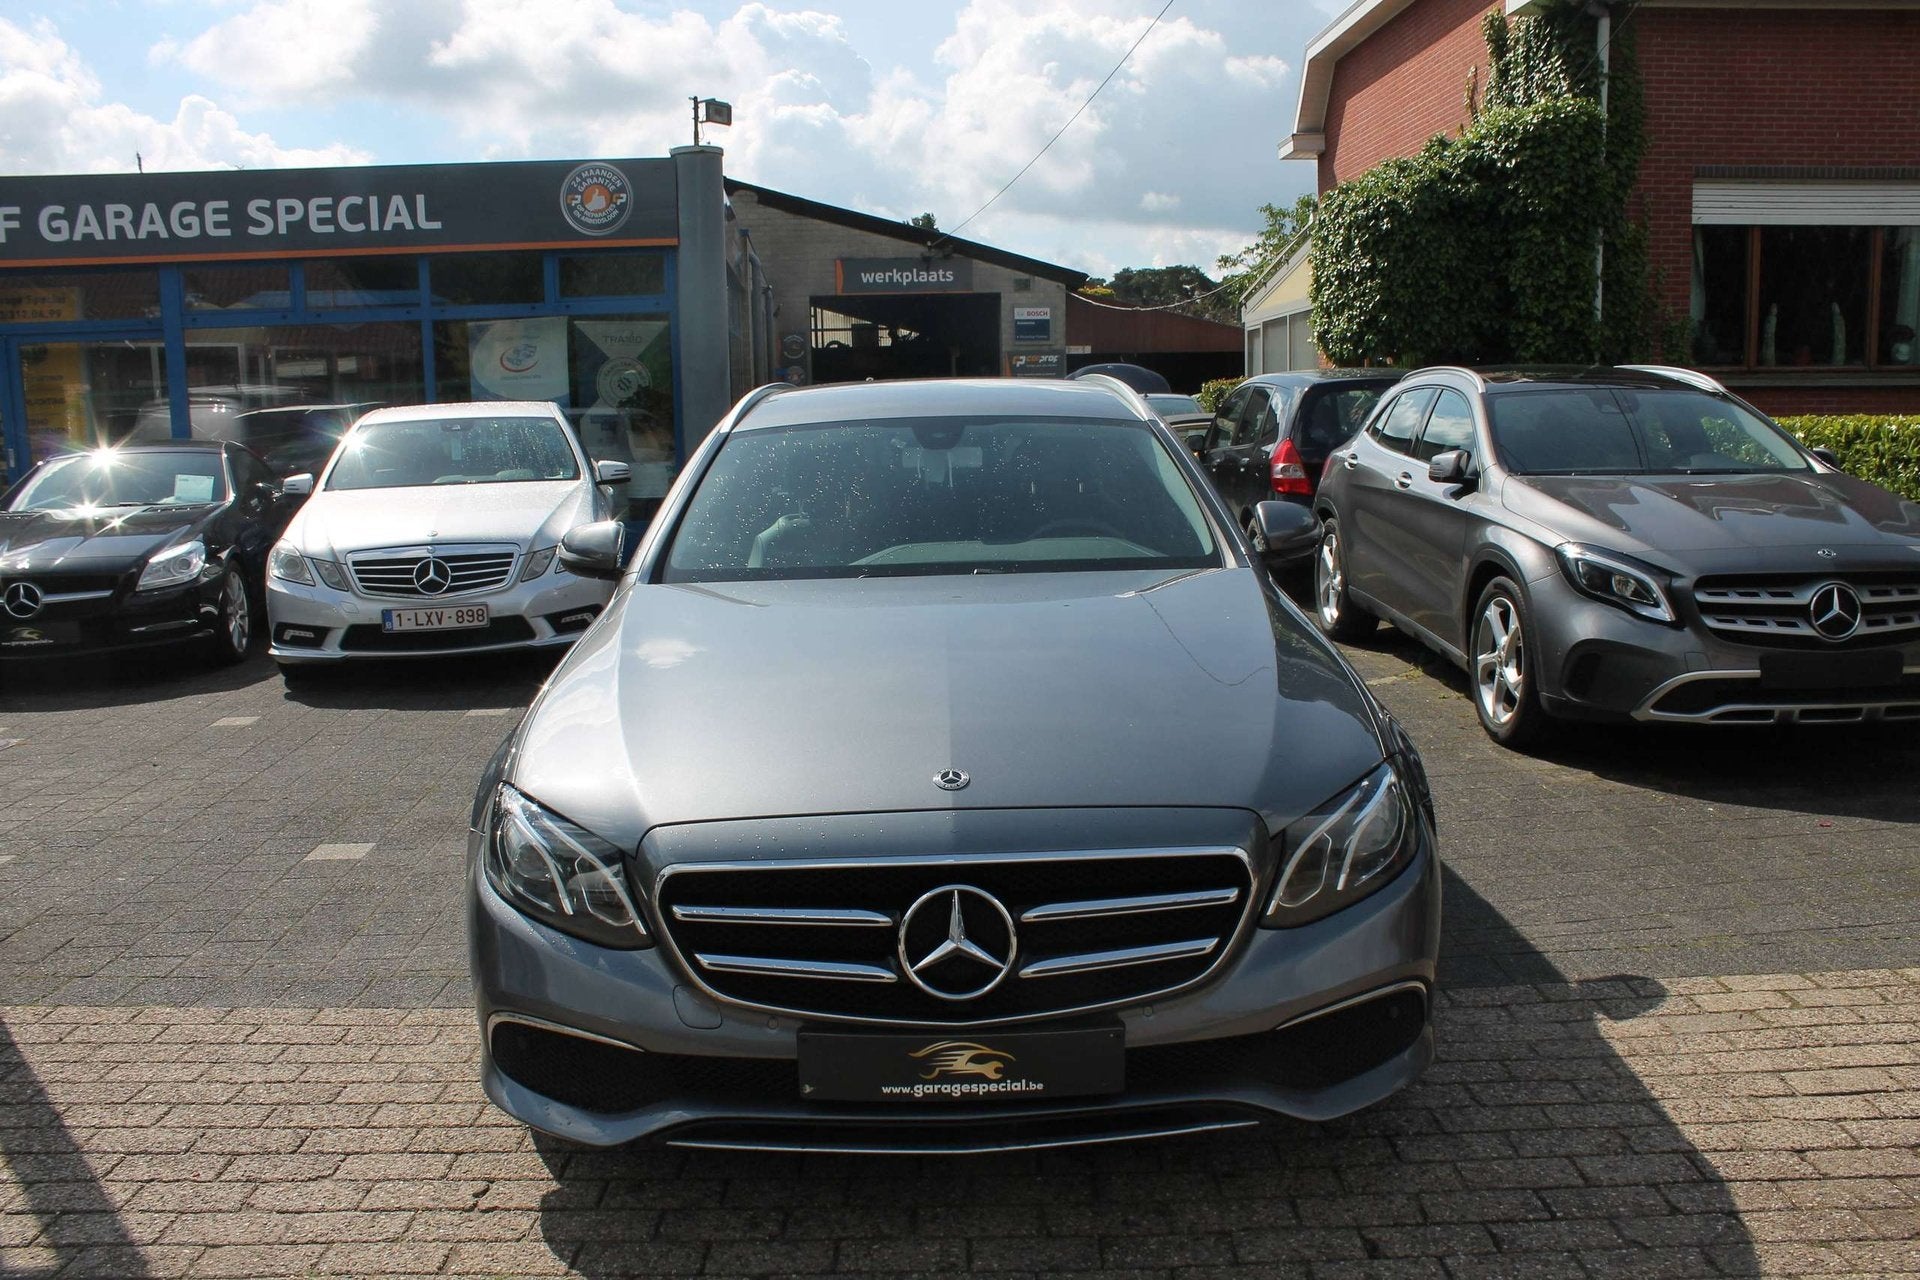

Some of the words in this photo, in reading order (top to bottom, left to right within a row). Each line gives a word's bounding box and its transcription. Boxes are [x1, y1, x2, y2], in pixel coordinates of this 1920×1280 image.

[571, 176, 581, 188] 24
[581, 168, 623, 187] MAANDEN
[578, 177, 617, 192] GARANTIE
[38, 201, 232, 242] GARAGE
[247, 194, 442, 236] SPECIAL
[861, 268, 954, 286] werkplaats
[396, 608, 485, 627] 1-LXV-898
[882, 1079, 1044, 1097] www.garagespecial.be
